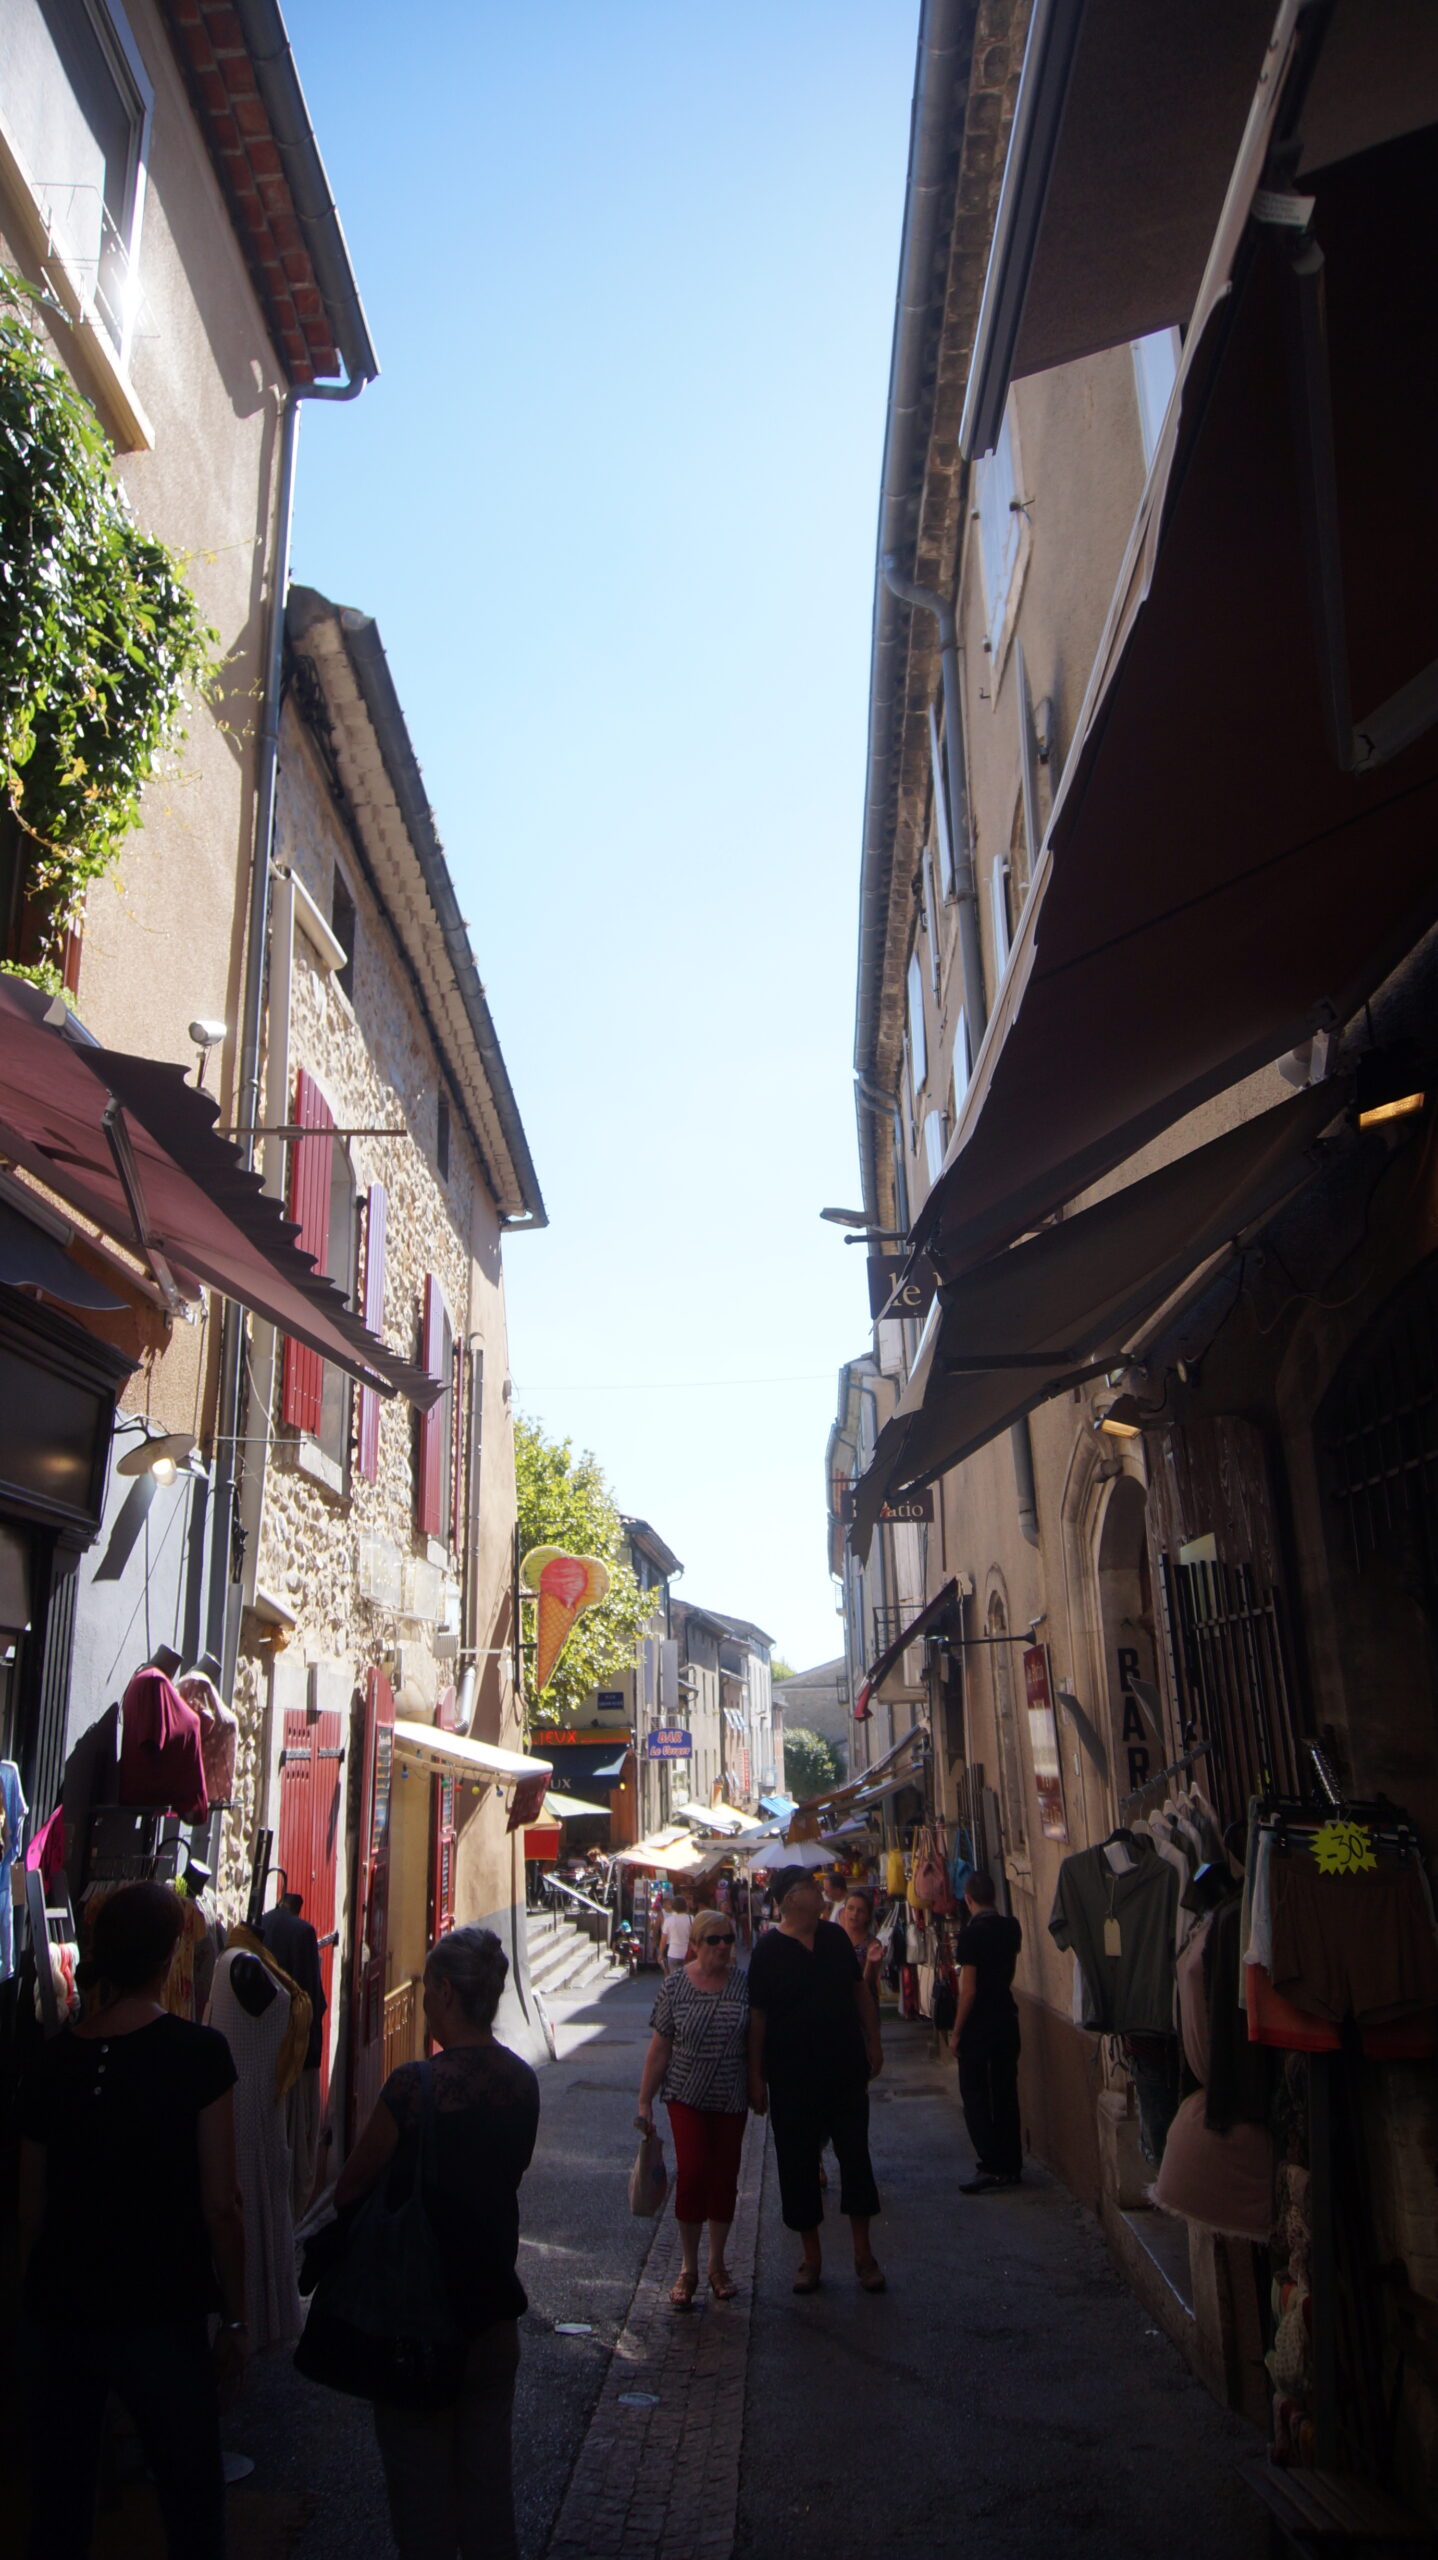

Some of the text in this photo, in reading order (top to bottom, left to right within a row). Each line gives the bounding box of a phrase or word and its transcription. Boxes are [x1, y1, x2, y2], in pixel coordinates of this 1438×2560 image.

[882, 1501, 924, 1518] atio
[657, 1731, 683, 1743] BAR
[550, 1778, 572, 1790] UX
